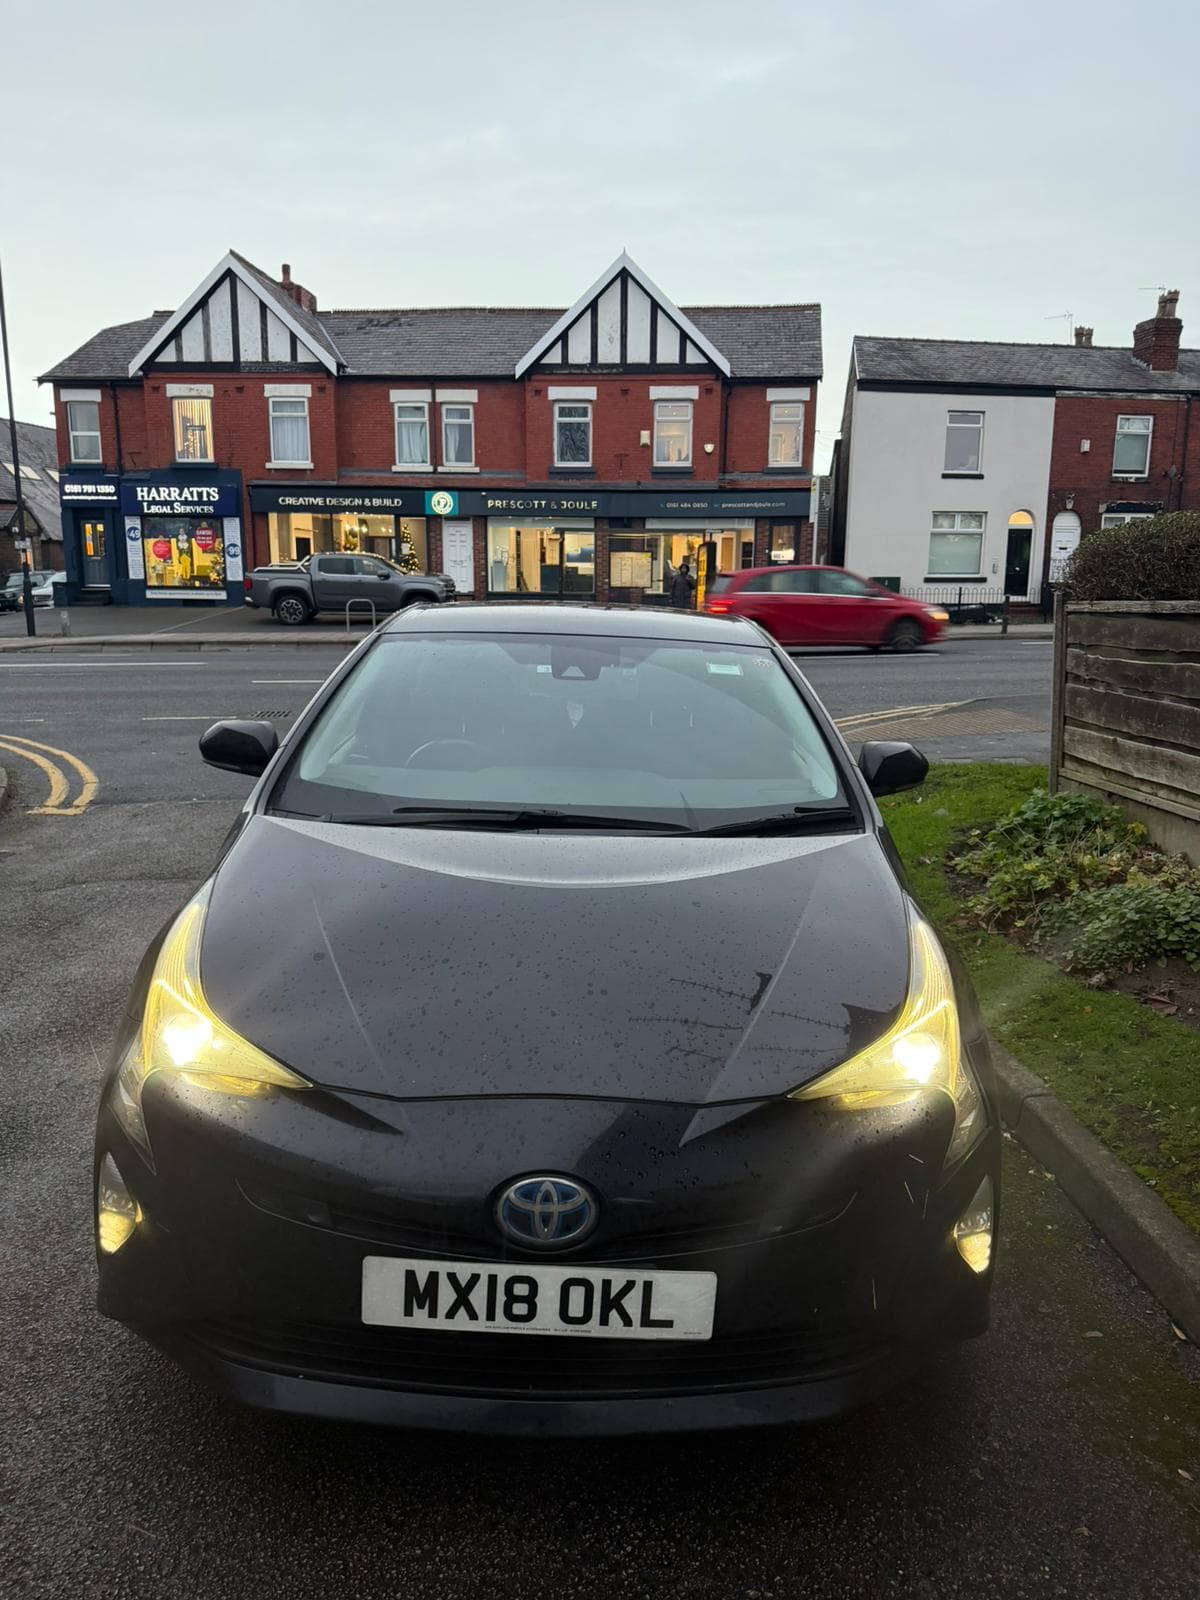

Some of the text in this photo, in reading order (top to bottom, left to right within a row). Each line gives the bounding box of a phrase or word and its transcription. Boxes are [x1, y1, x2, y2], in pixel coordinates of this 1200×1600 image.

[136, 486, 220, 502] HARRATTS
[278, 496, 403, 507] CREATIVE DESIGN & BUILD
[487, 499, 599, 510] PRESCOTT & JOULE
[403, 1269, 675, 1328] MX18 OKL
